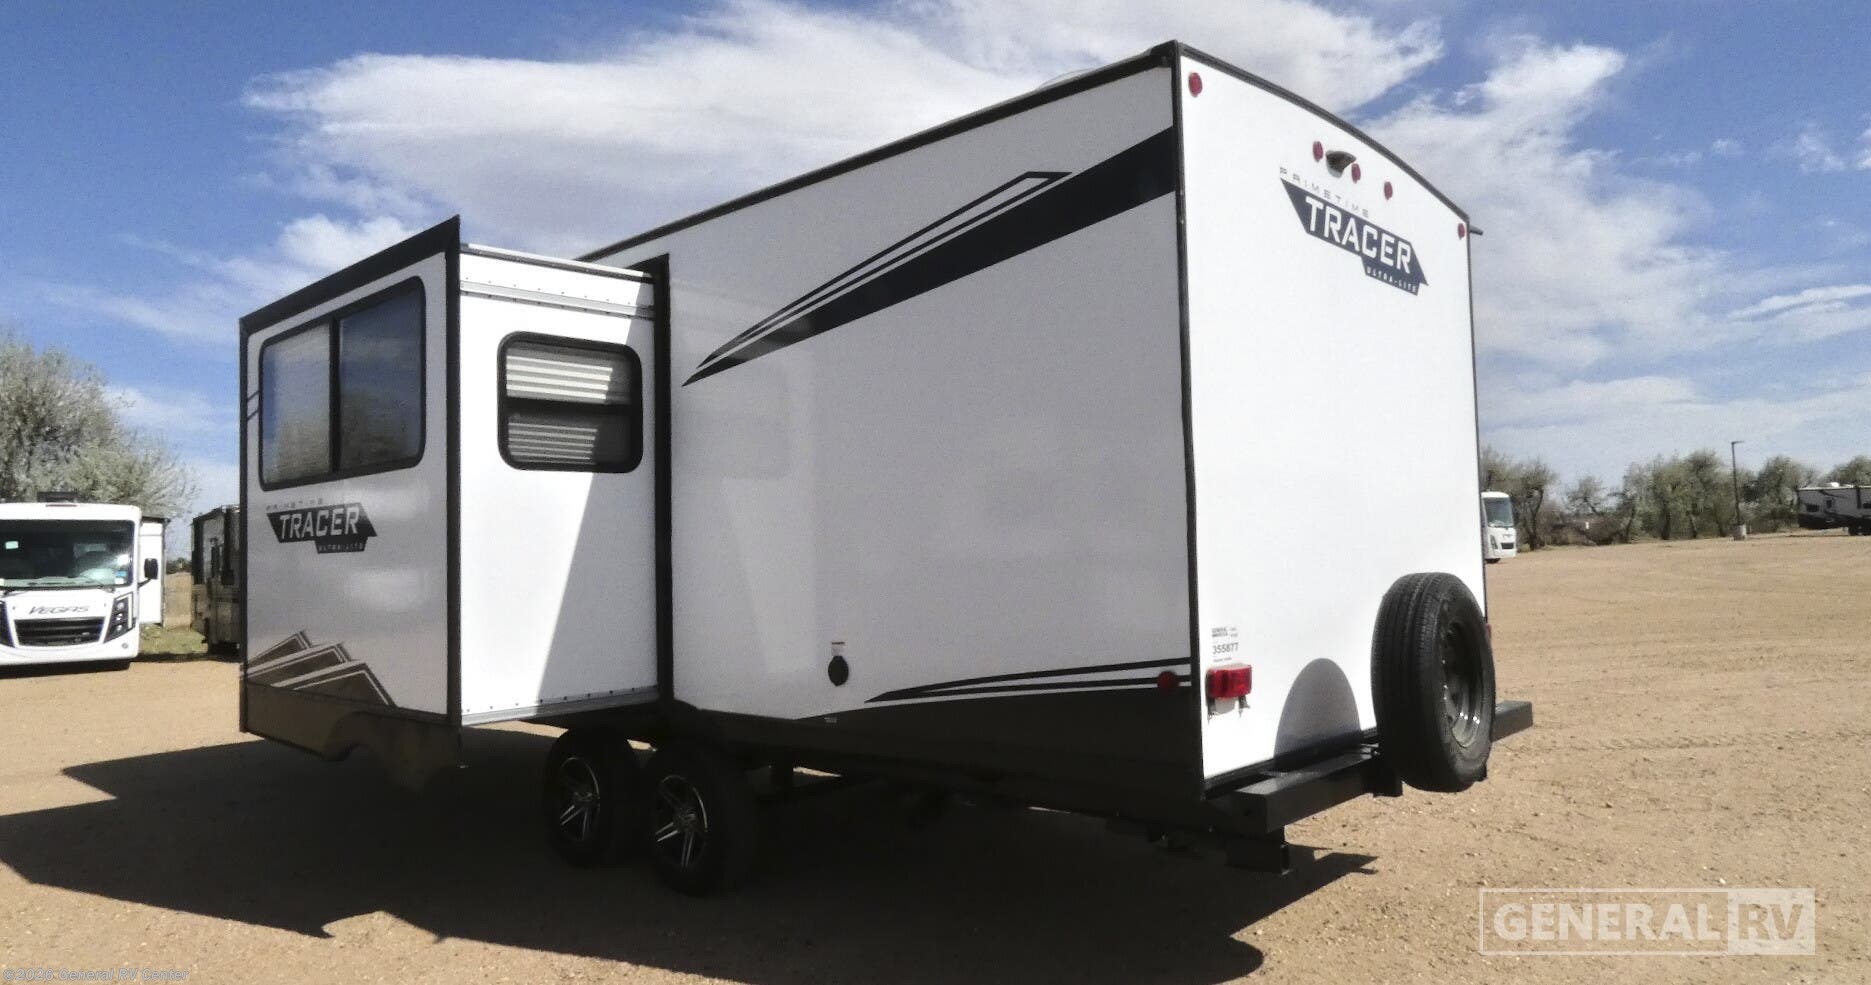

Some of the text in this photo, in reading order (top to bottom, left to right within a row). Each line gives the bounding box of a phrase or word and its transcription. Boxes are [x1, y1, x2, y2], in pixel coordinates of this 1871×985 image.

[1305, 195, 1412, 275] TRACER
[280, 506, 360, 540] TRACER
[29, 605, 90, 615] VEGAS
